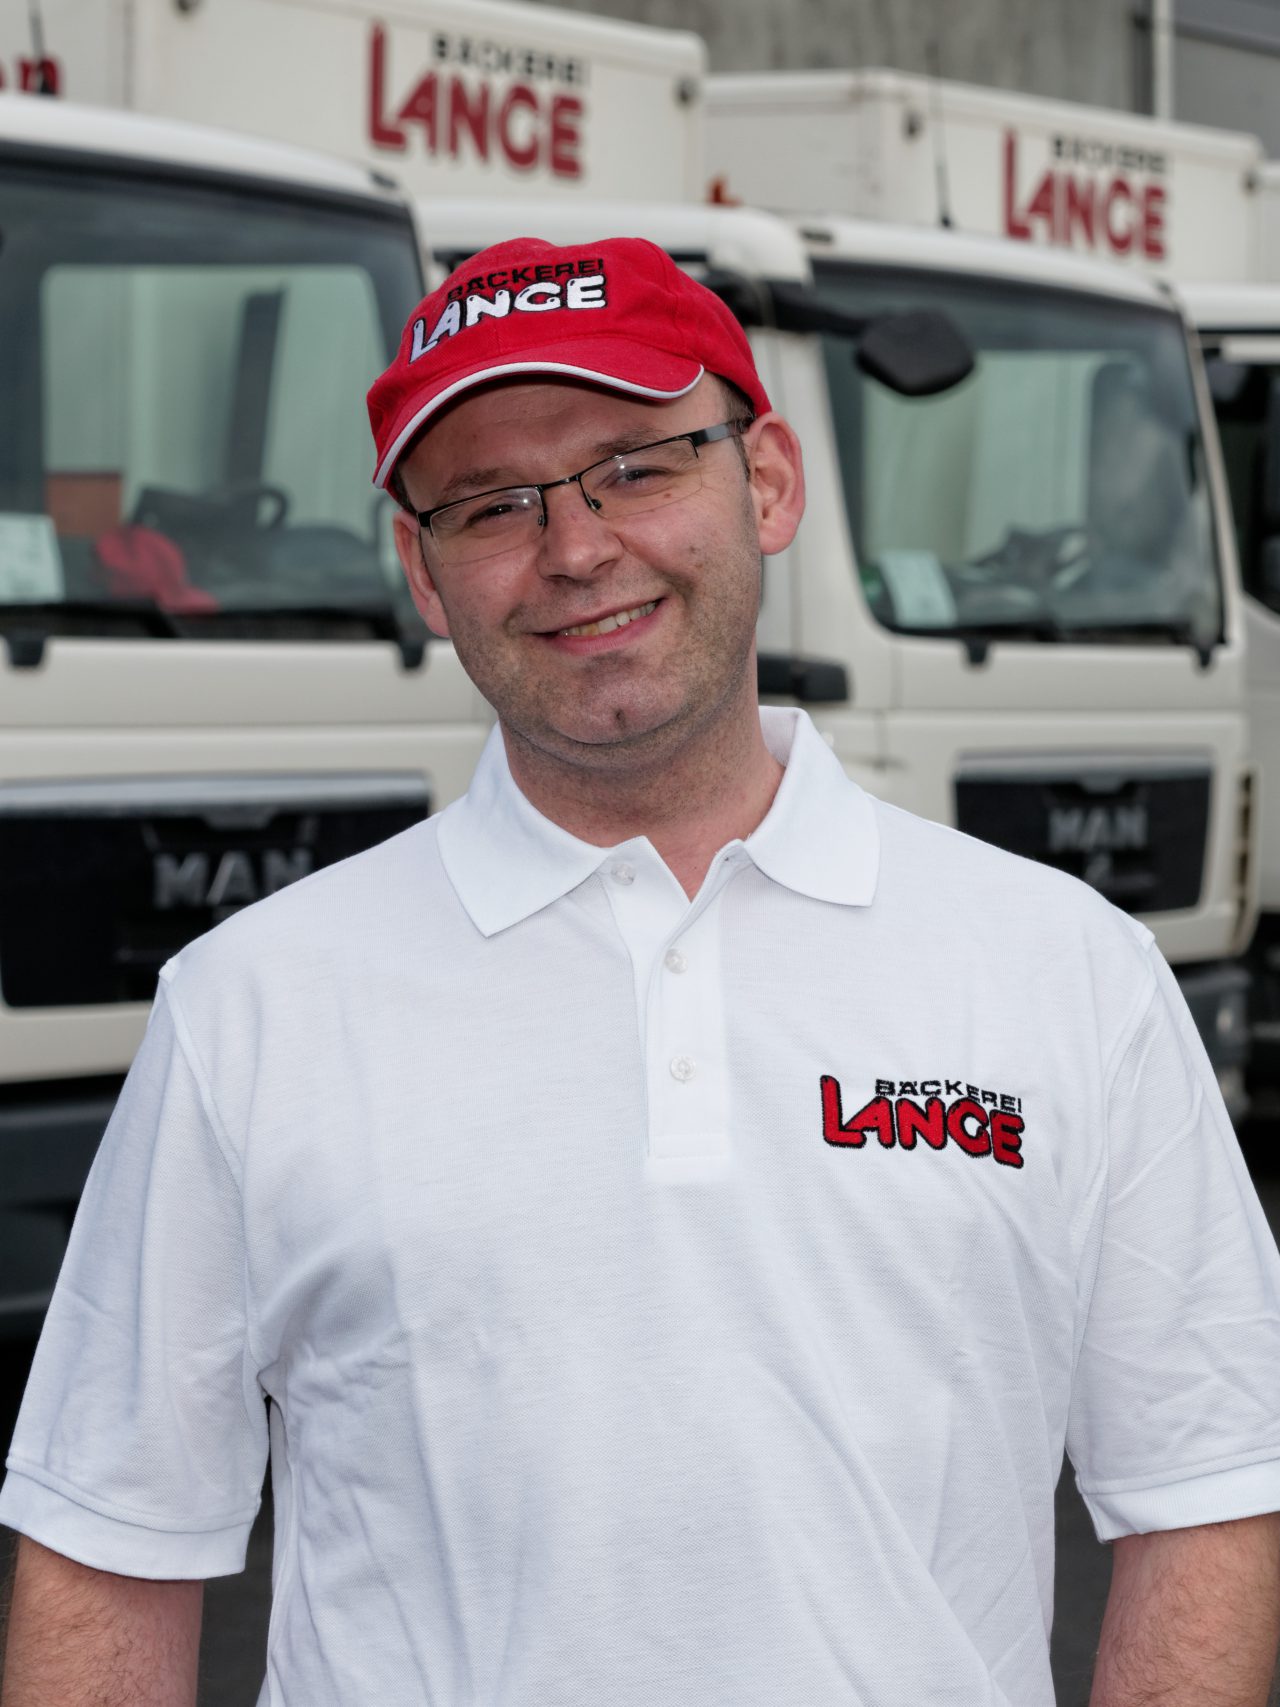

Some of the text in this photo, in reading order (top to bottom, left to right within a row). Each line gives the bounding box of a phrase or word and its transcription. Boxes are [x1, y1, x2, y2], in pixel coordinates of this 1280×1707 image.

[370, 21, 582, 178] LANGE
[1003, 128, 1166, 261] LANGE
[409, 273, 608, 364] LANGE
[1047, 805, 1147, 850] MAN
[153, 850, 312, 907] MAN
[819, 1074, 1026, 1169] LANGE
[875, 1078, 1022, 1113] BÄCKEREI
